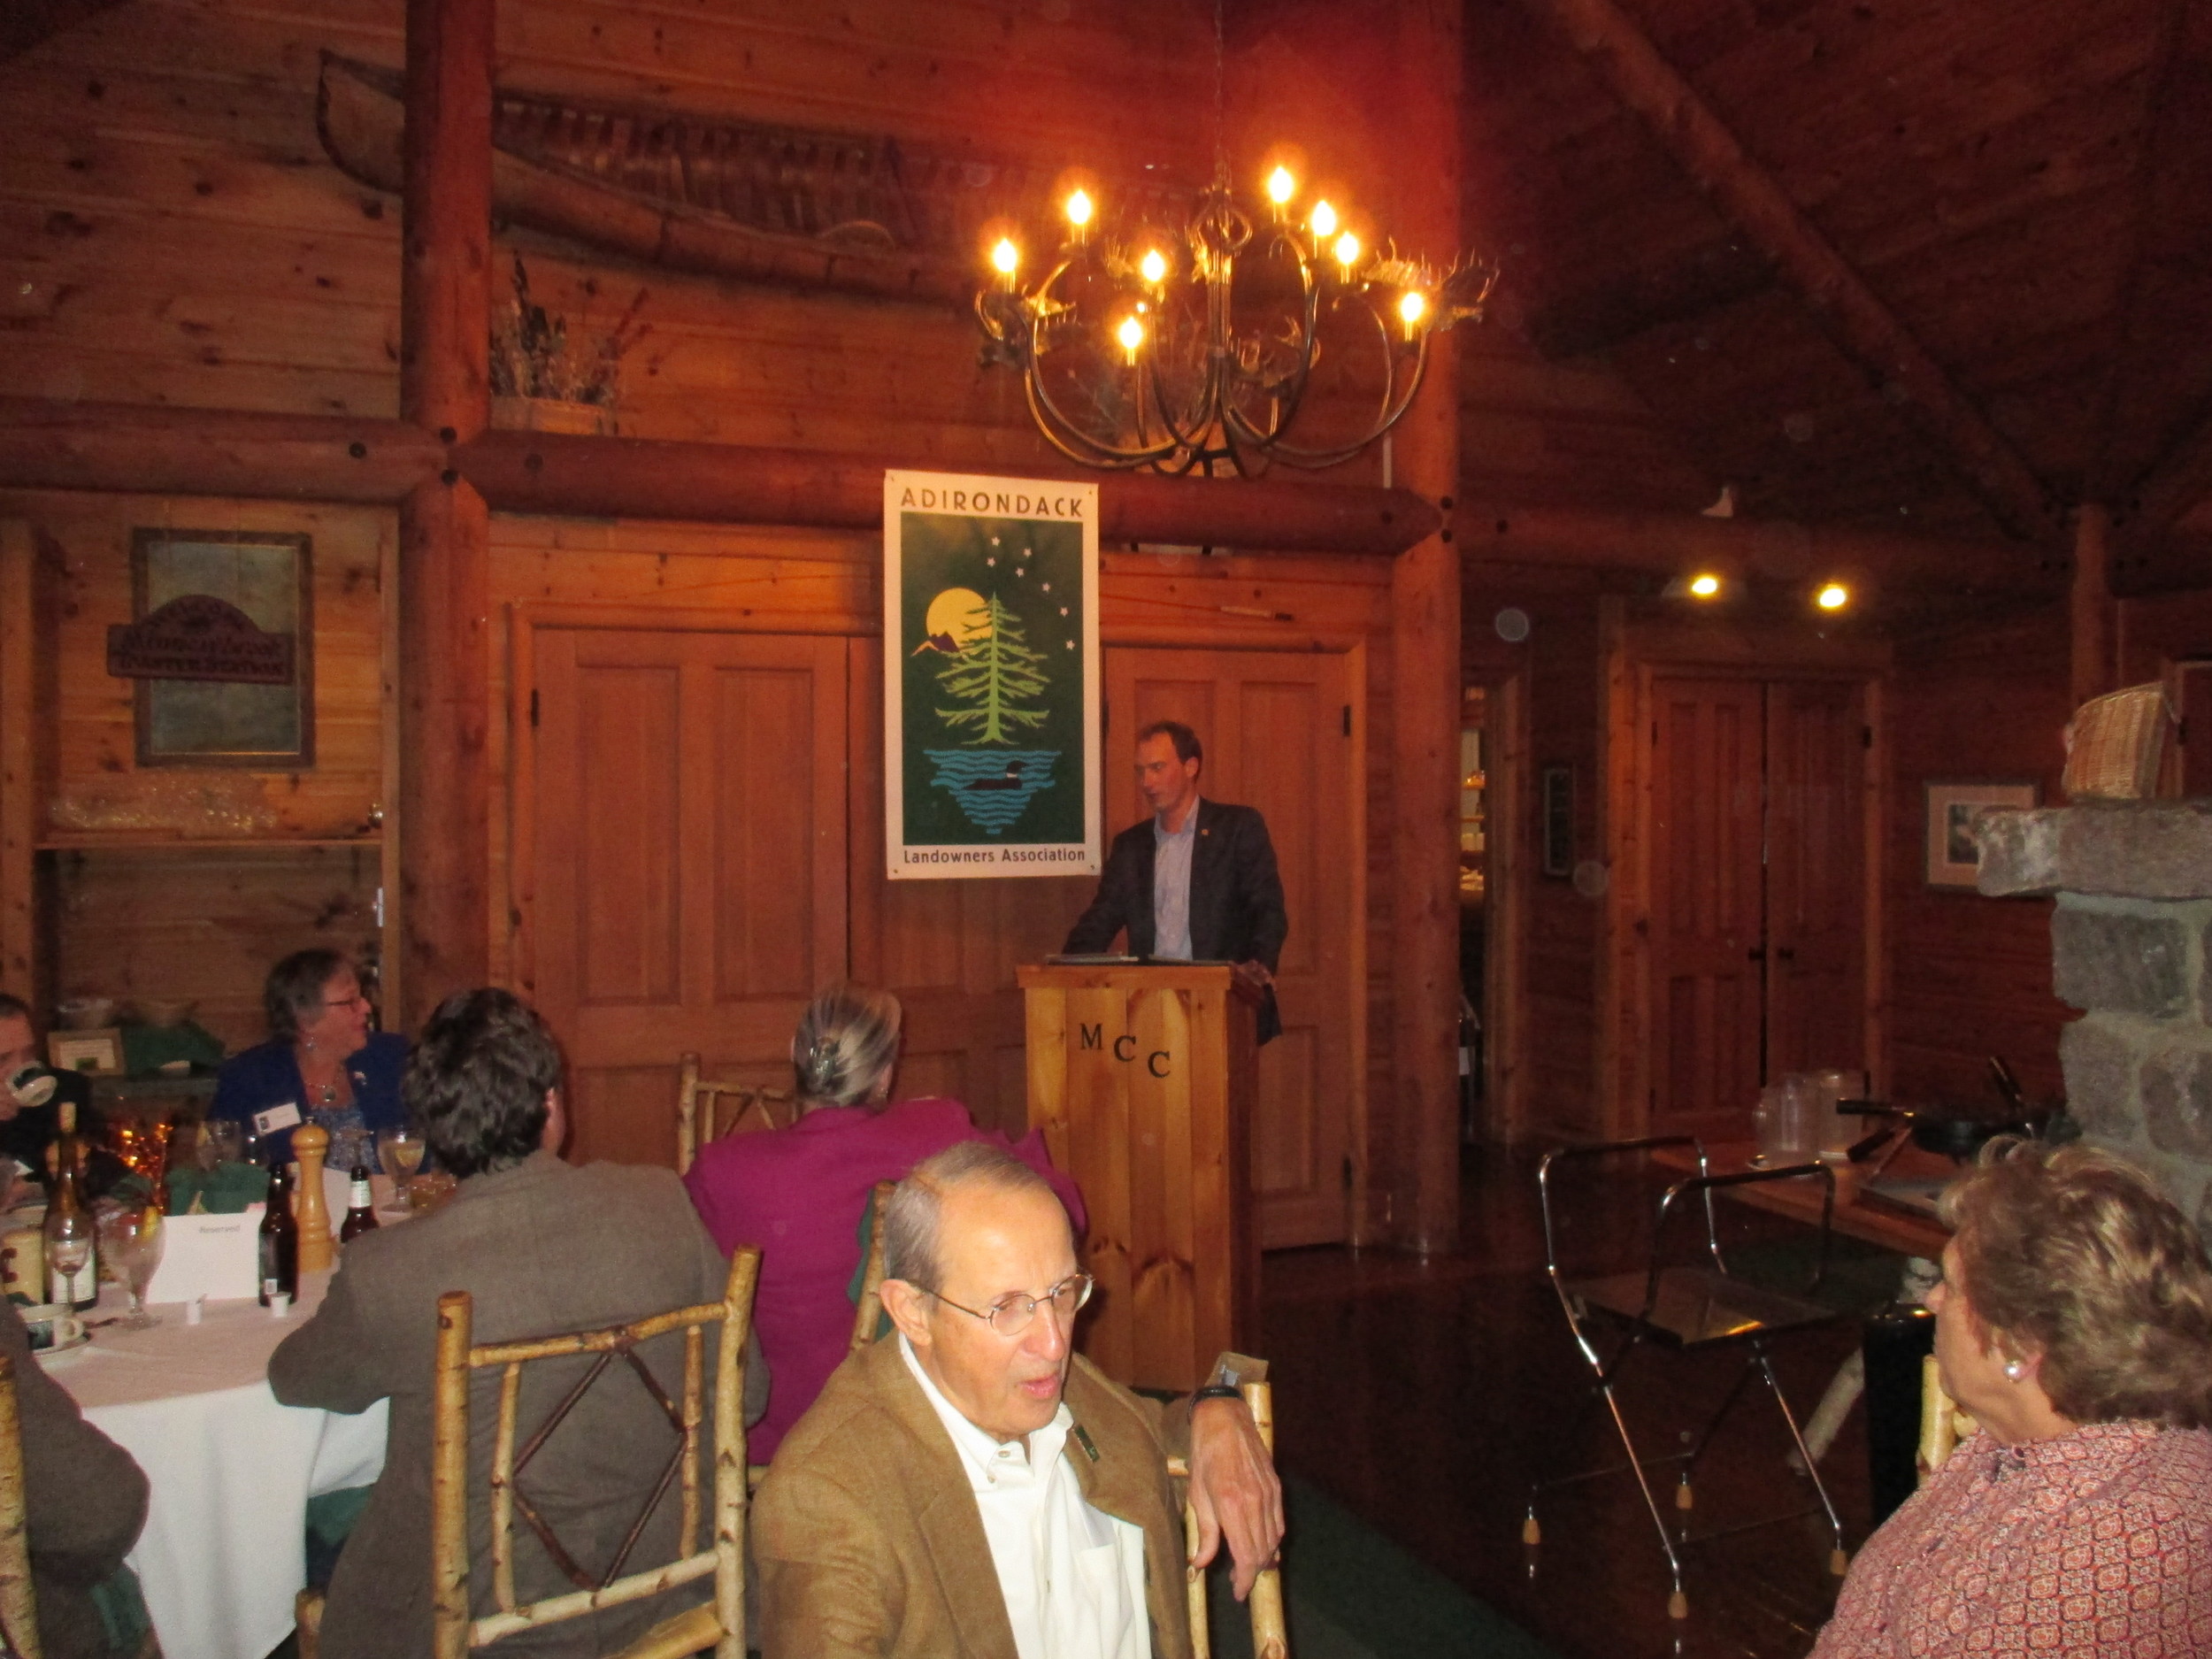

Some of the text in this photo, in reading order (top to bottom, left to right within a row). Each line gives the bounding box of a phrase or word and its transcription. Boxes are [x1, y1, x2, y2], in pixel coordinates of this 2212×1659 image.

[901, 488, 1082, 518] ADIRONDACK
[904, 848, 1086, 864] Landowners Association
